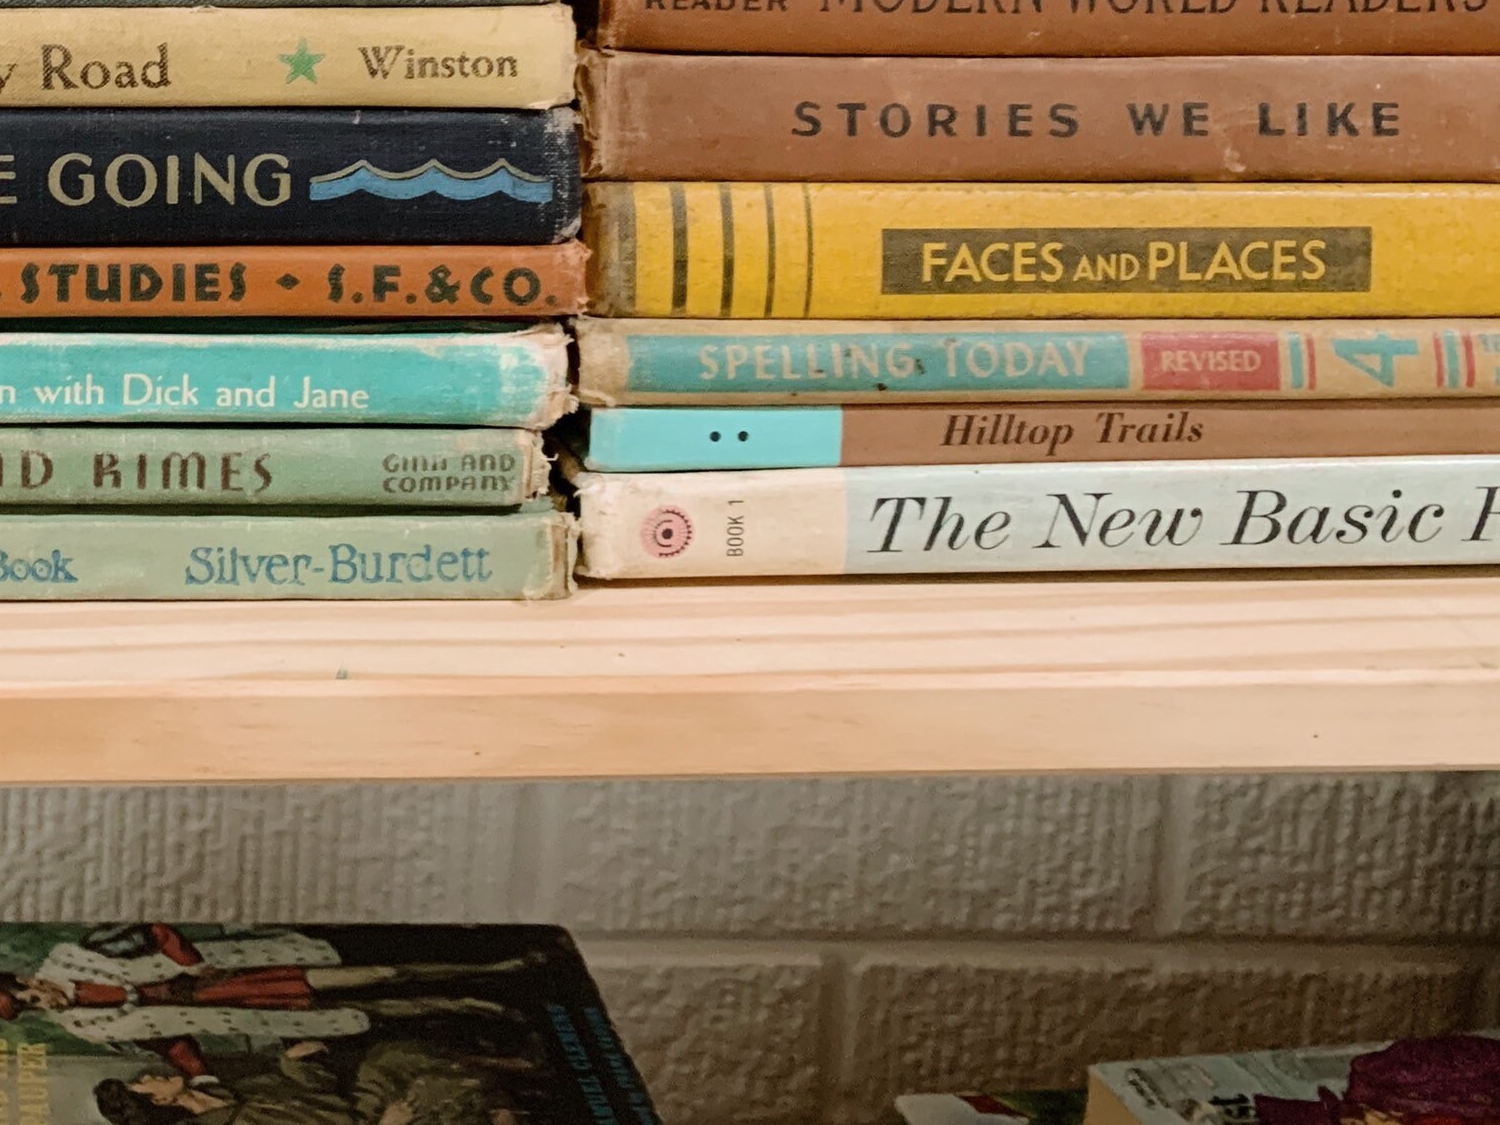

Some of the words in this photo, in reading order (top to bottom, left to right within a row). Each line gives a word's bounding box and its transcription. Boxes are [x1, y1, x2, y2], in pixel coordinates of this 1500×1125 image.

[41, 41, 173, 92] Road
[358, 44, 520, 81] Winston
[790, 100, 1080, 139] STORIES
[1124, 101, 1211, 137] WE
[1257, 101, 1401, 138] LIKE
[47, 151, 292, 208] GOING
[20, 261, 248, 305] STUDIES
[921, 241, 1065, 285] FACES
[1072, 254, 1141, 282] AND
[1147, 239, 1328, 282] PLACES
[699, 341, 916, 381] SPELLING
[941, 338, 1095, 380] TODAY
[1160, 349, 1262, 374] REVISED
[1331, 331, 1420, 388] 4
[33, 375, 105, 406] with
[123, 372, 200, 407] Dick
[215, 376, 277, 408] and
[293, 377, 372, 410] Jane
[939, 411, 1075, 458] Hilltop
[1094, 410, 1206, 446] Trails
[92, 450, 274, 494] RIMES
[381, 452, 449, 473] GINN
[459, 452, 517, 472] AND
[381, 473, 515, 494] COMPANY
[726, 515, 745, 557] BOOK
[865, 495, 1014, 555] The
[1031, 491, 1205, 550] New
[1217, 487, 1447, 548] Basic
[184, 542, 494, 587] Silver-Burdett
